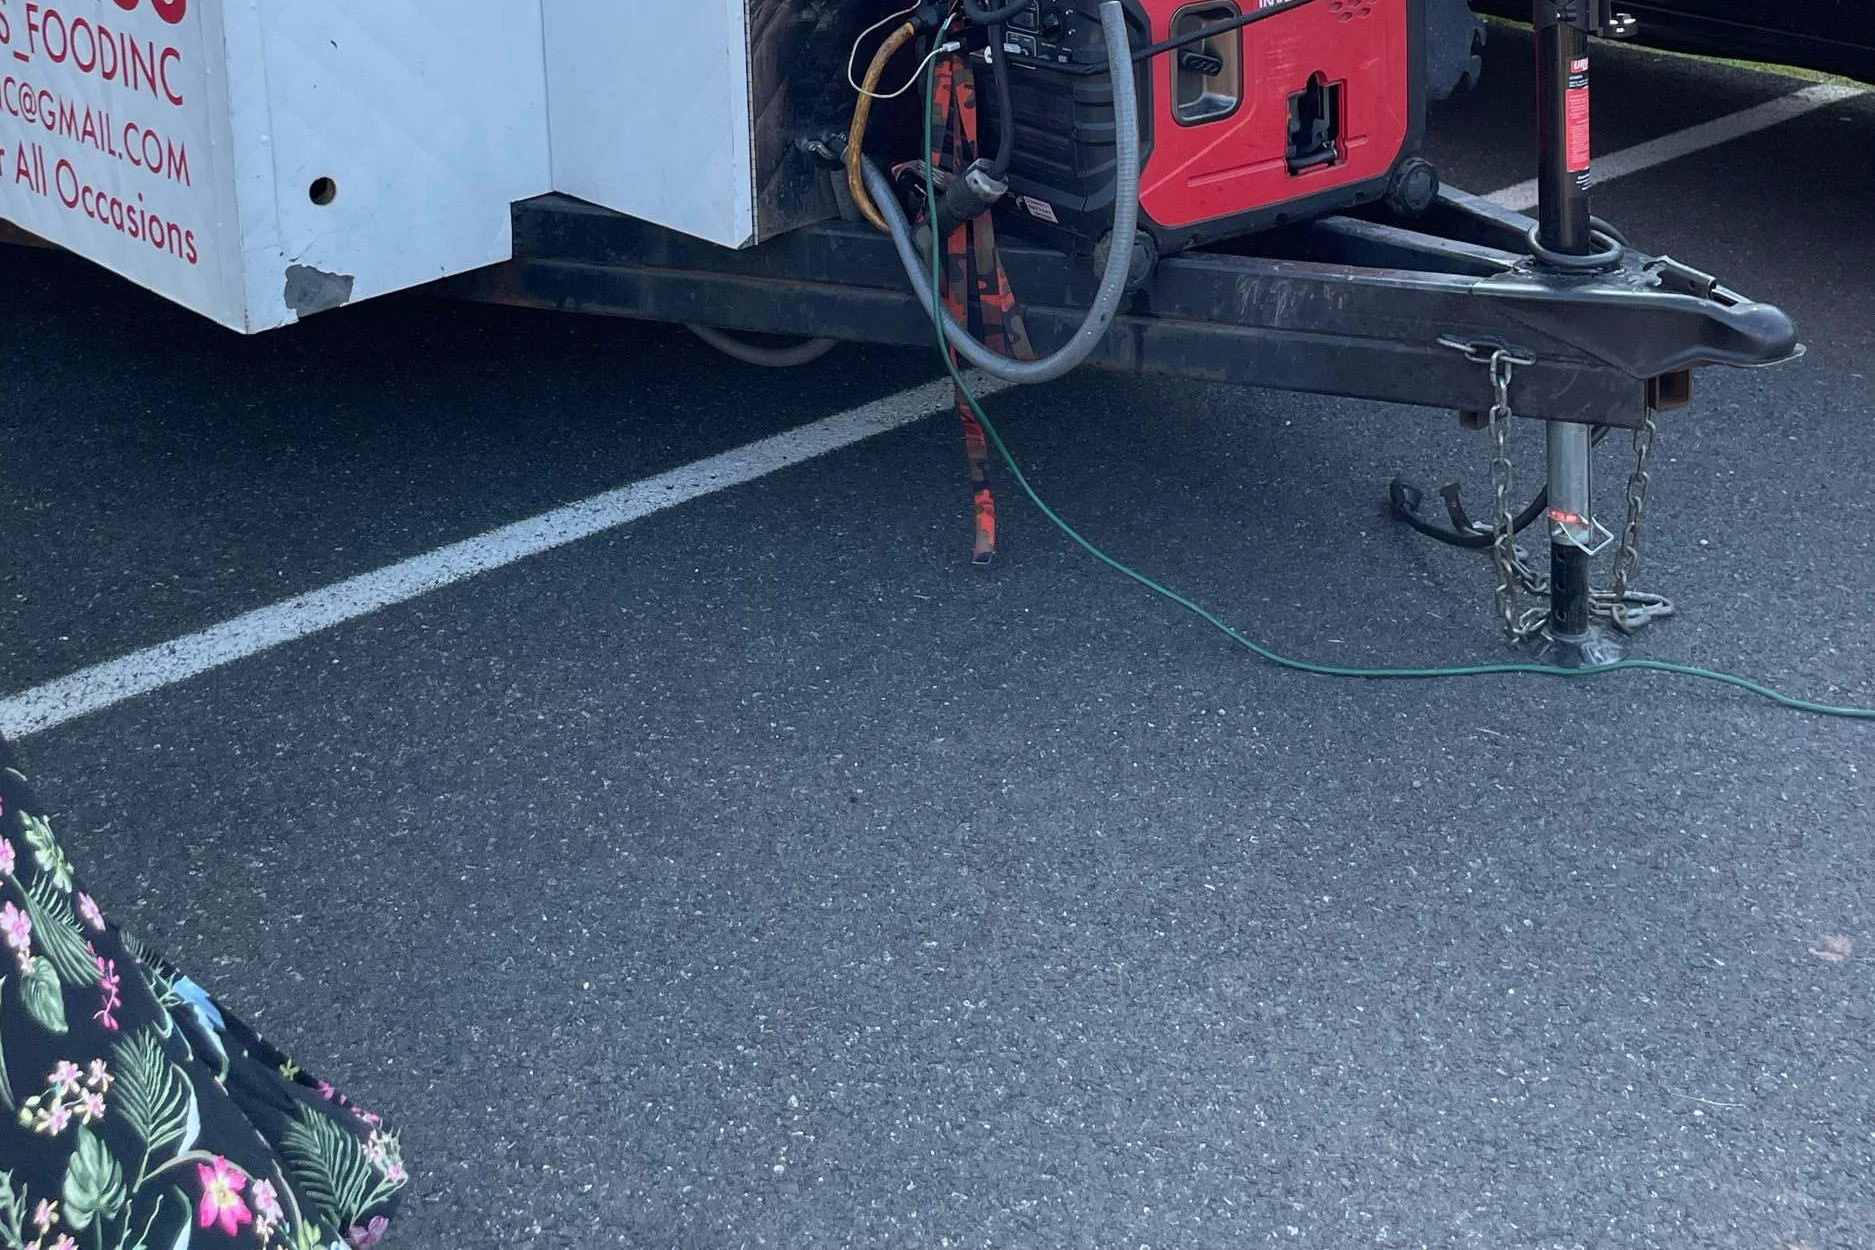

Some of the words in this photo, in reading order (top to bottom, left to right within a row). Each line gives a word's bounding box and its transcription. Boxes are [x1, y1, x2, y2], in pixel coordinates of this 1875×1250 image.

[0, 76, 191, 187] C@GMAIL.COM
[15, 140, 48, 197] All
[55, 158, 198, 265] Occasions
